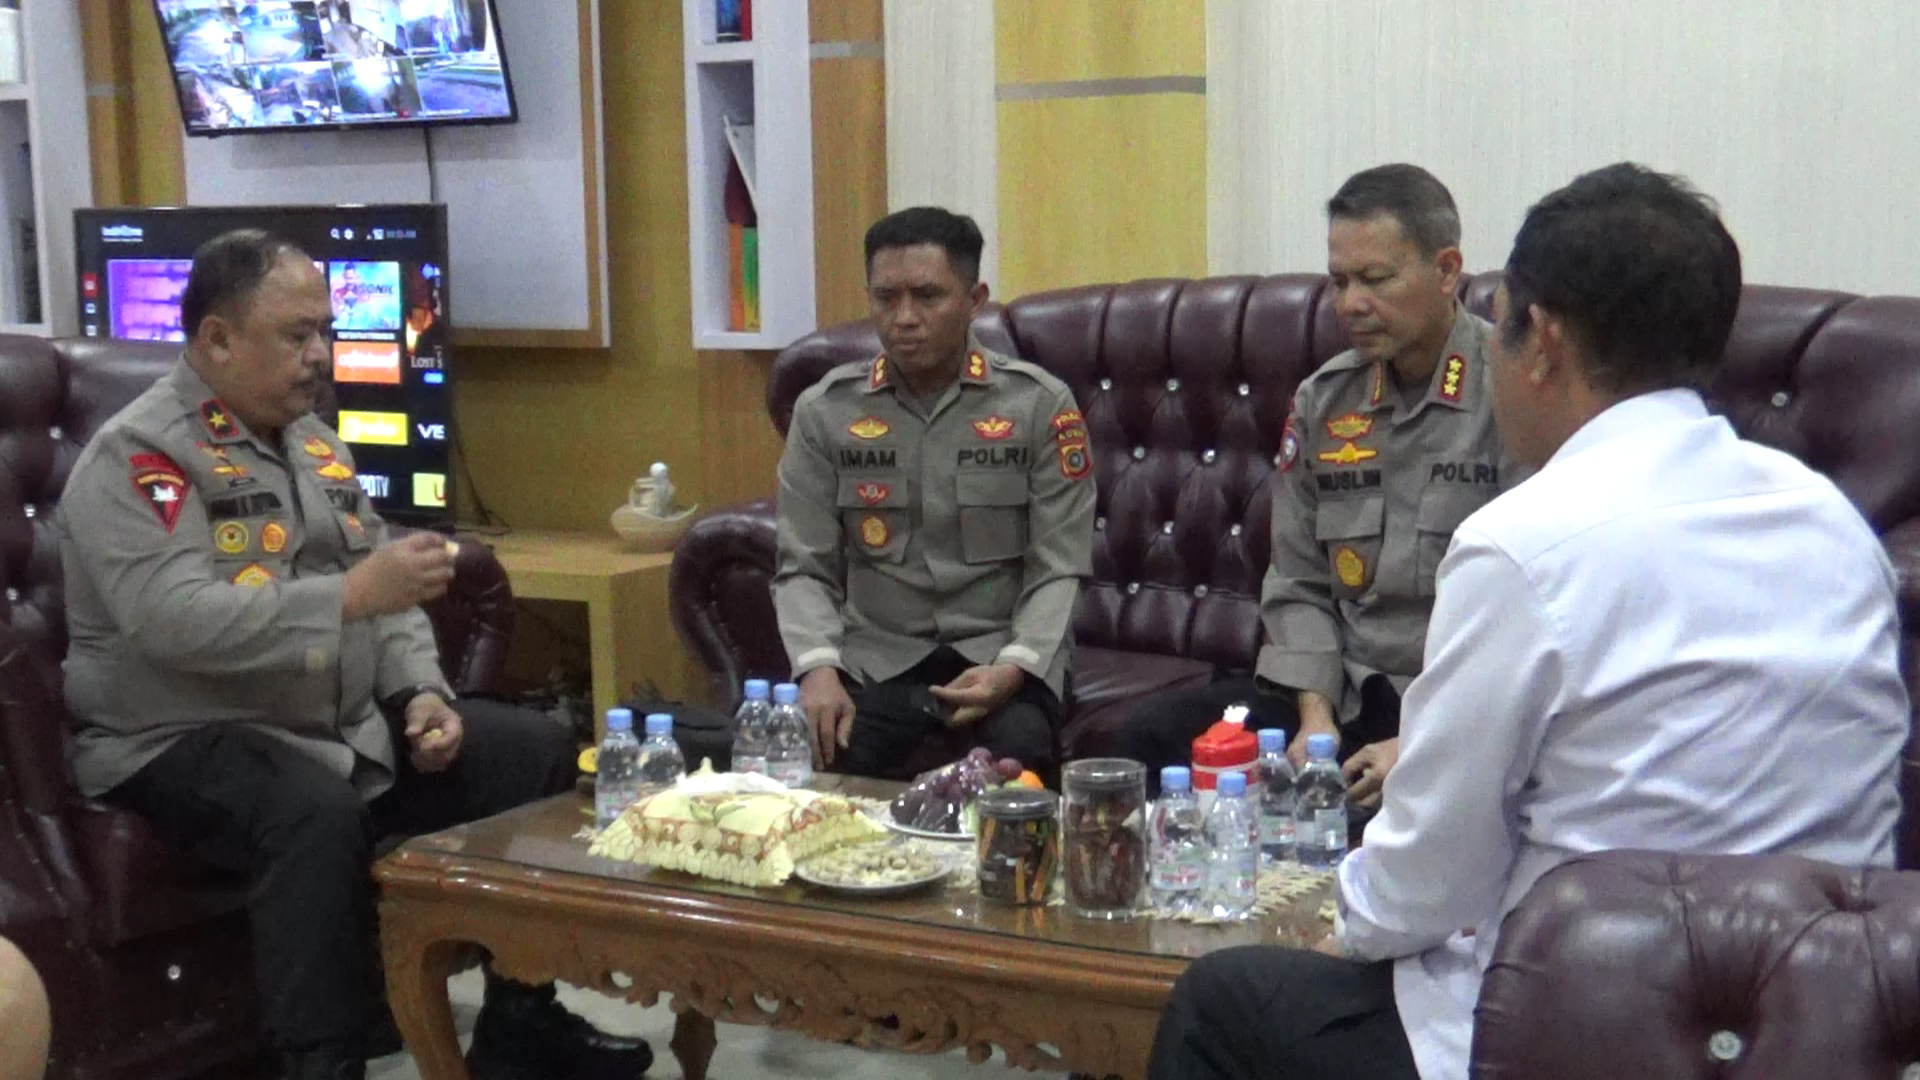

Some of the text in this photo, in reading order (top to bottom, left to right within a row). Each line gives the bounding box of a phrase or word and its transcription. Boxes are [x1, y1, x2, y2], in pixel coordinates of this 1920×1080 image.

[411, 356, 434, 369] LOST
[839, 450, 896, 468] IMAM
[957, 446, 1028, 466] POLRI
[1430, 462, 1499, 483] POLRI
[356, 474, 390, 498] POTV
